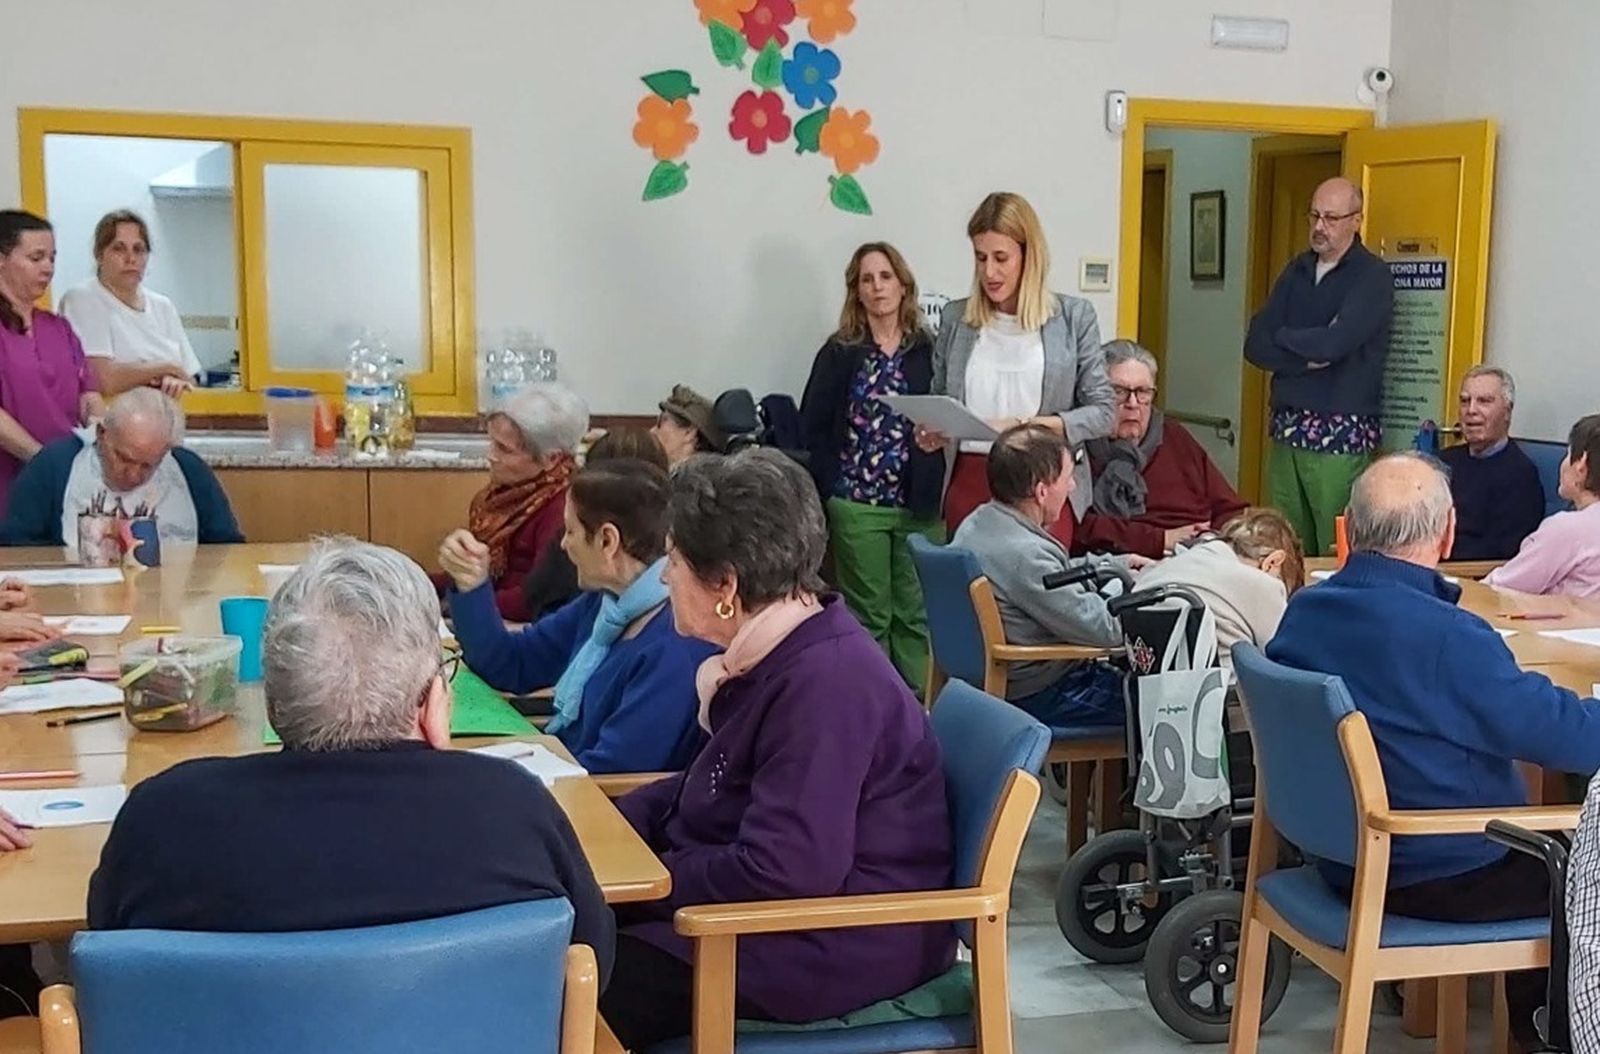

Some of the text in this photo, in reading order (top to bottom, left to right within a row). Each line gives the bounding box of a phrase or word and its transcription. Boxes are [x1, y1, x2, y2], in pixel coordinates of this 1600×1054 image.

[1419, 263, 1430, 274] DE
[1432, 263, 1443, 274] LA
[1413, 277, 1442, 288] MAYOR
